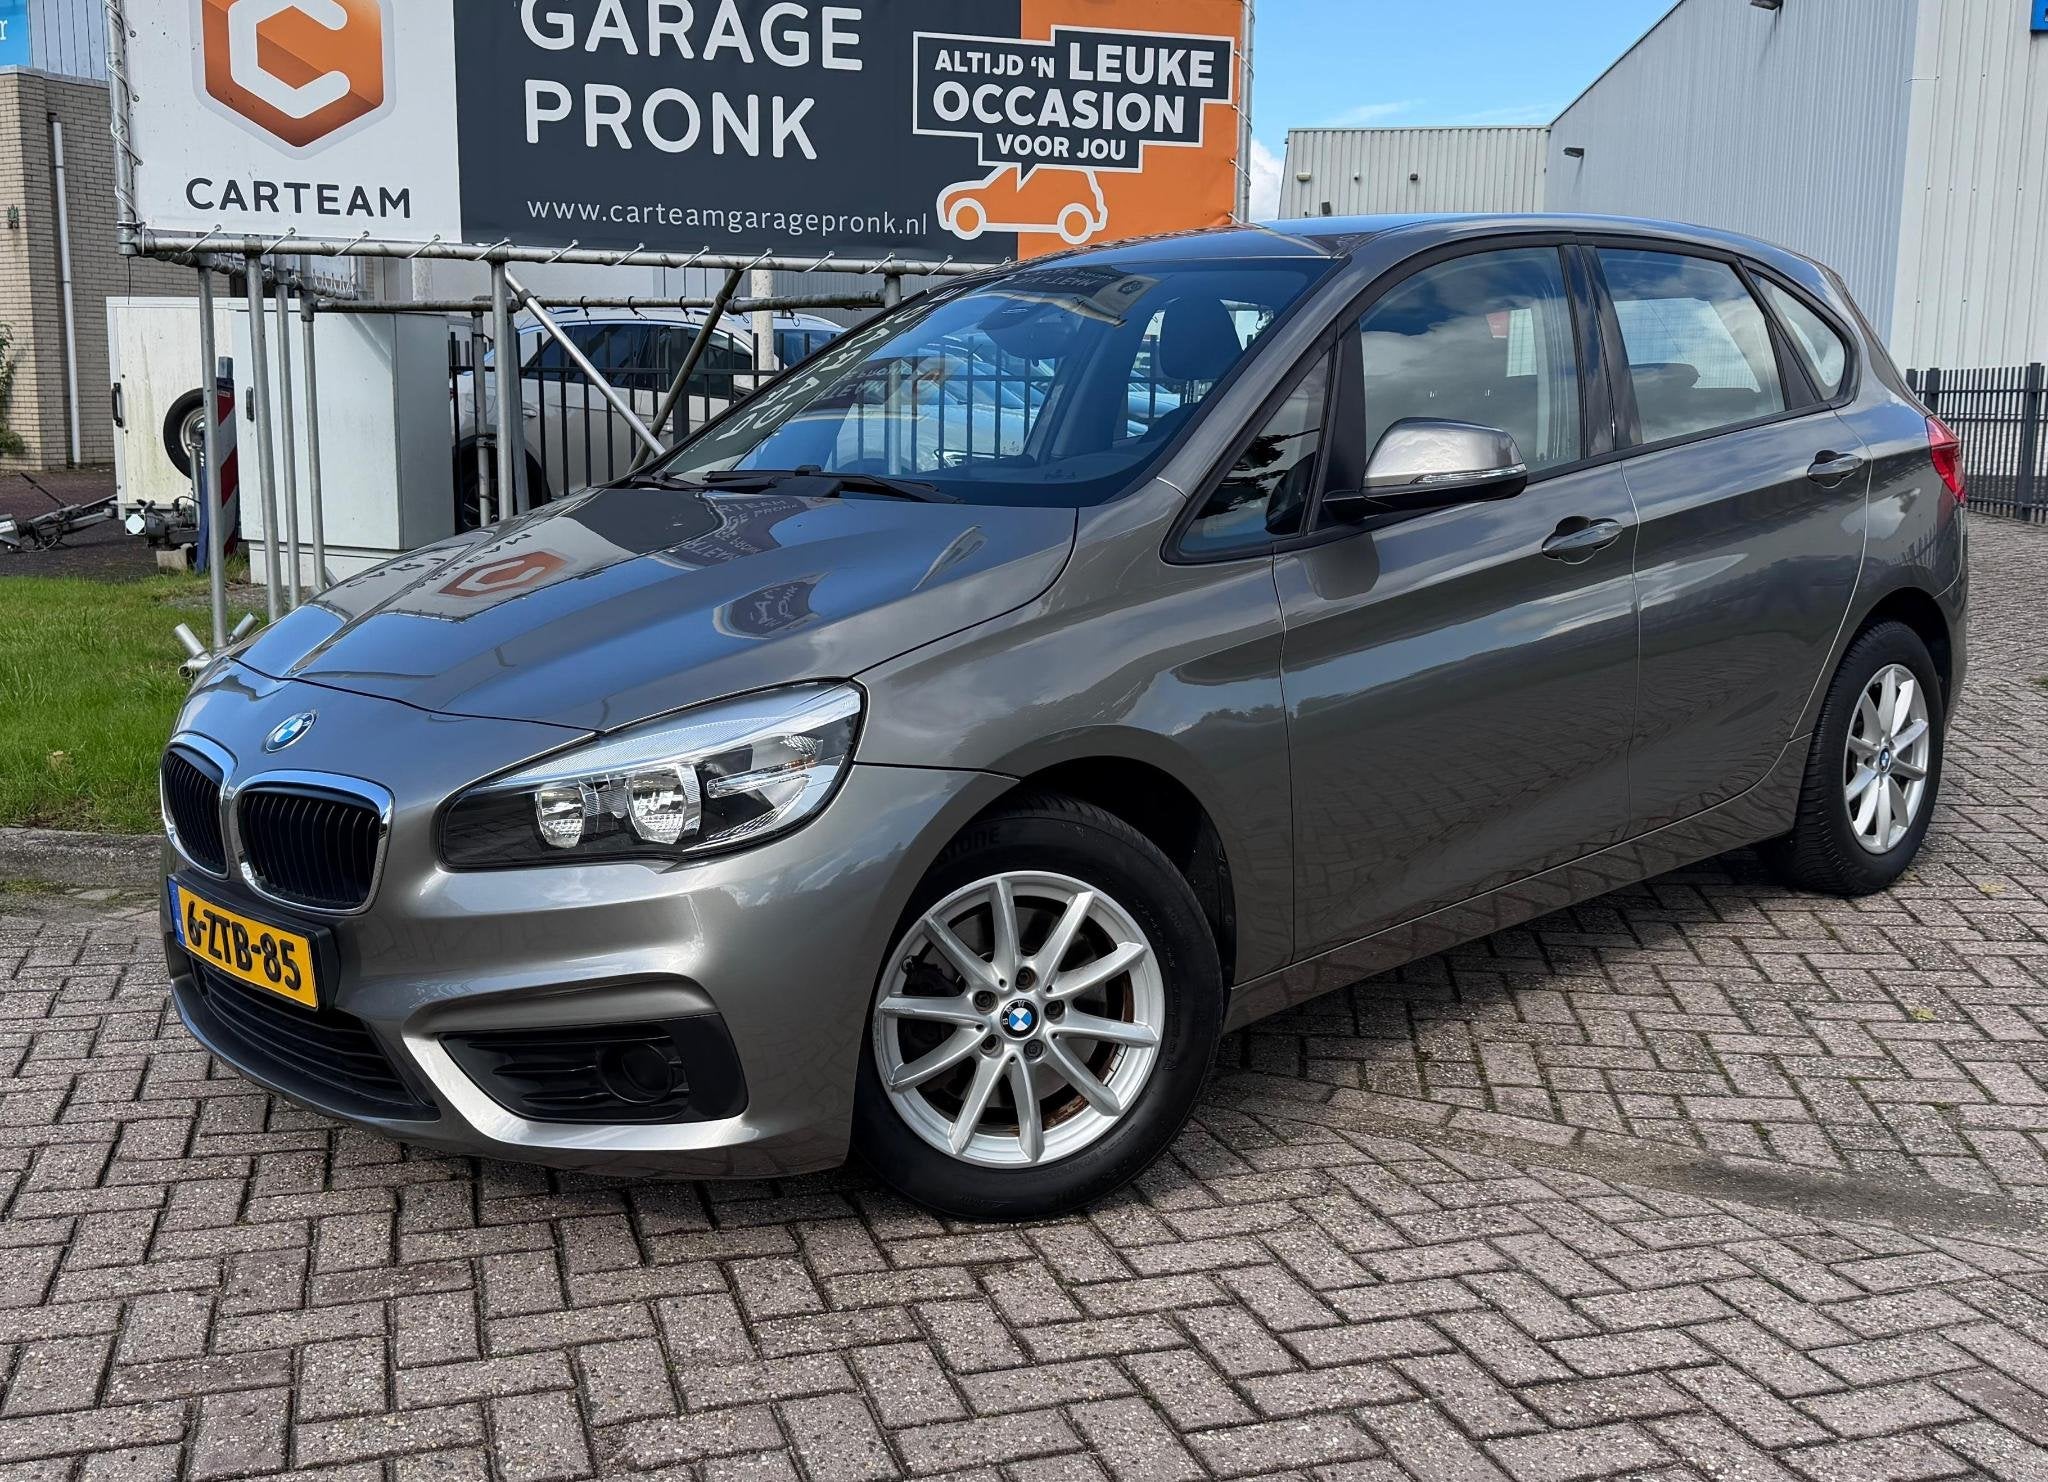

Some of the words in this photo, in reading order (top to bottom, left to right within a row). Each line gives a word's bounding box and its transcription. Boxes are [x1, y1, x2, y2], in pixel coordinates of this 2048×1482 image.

[520, 0, 863, 71] GARAGE
[934, 48, 1025, 77] ALTIJD
[1069, 42, 1215, 88] LEUKE
[525, 79, 818, 160] PRONK
[932, 80, 1185, 134] OCCASION
[996, 133, 1070, 158] VOOR
[1076, 137, 1126, 161] JOU
[185, 177, 411, 219] CARTEAM
[527, 200, 927, 237] www.carteamgaragepronk.nl
[187, 900, 302, 991] 6-ZTB-85
